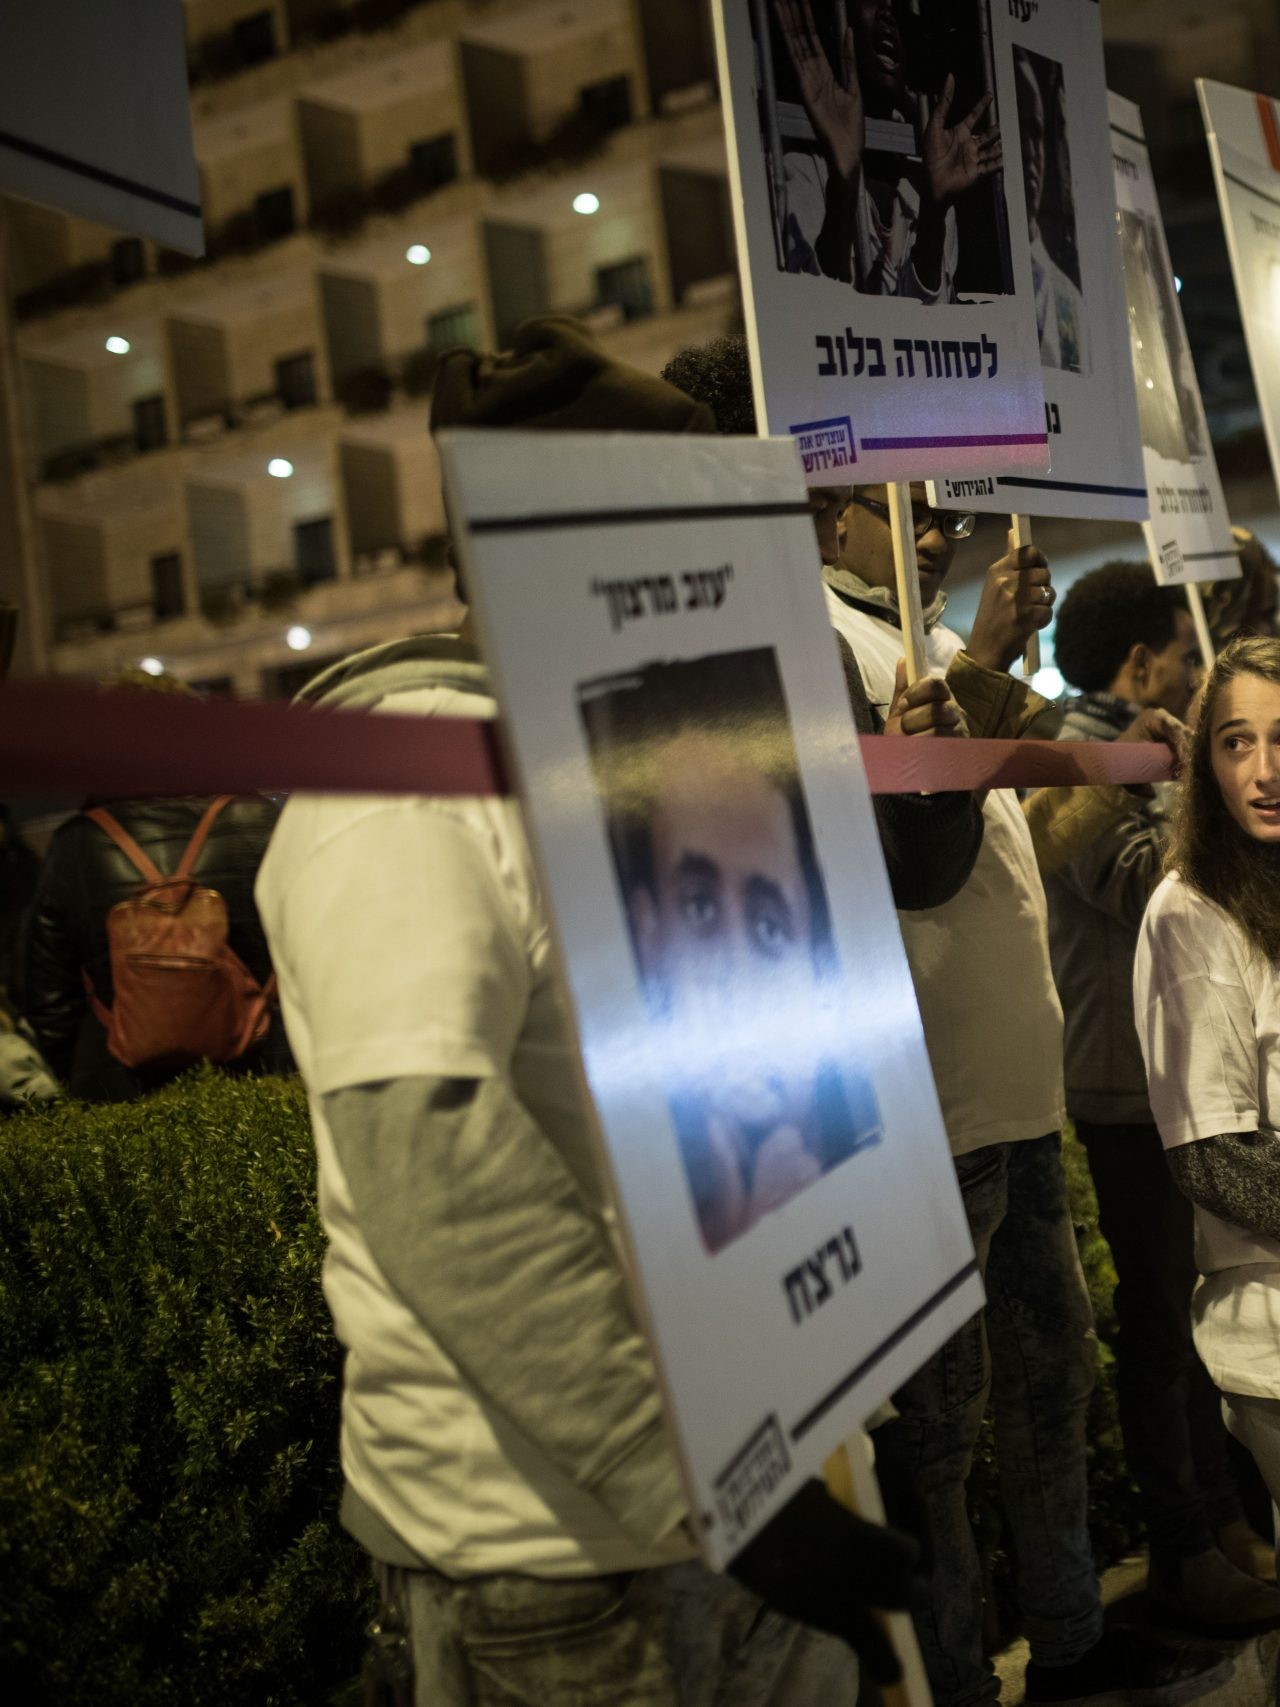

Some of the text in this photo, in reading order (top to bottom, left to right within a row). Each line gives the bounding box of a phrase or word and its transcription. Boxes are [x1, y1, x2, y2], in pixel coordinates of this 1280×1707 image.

[815, 326, 998, 379] לסחורה בלוב
[798, 429, 846, 451] עוצרים את
[781, 1221, 865, 1328] נרצח
